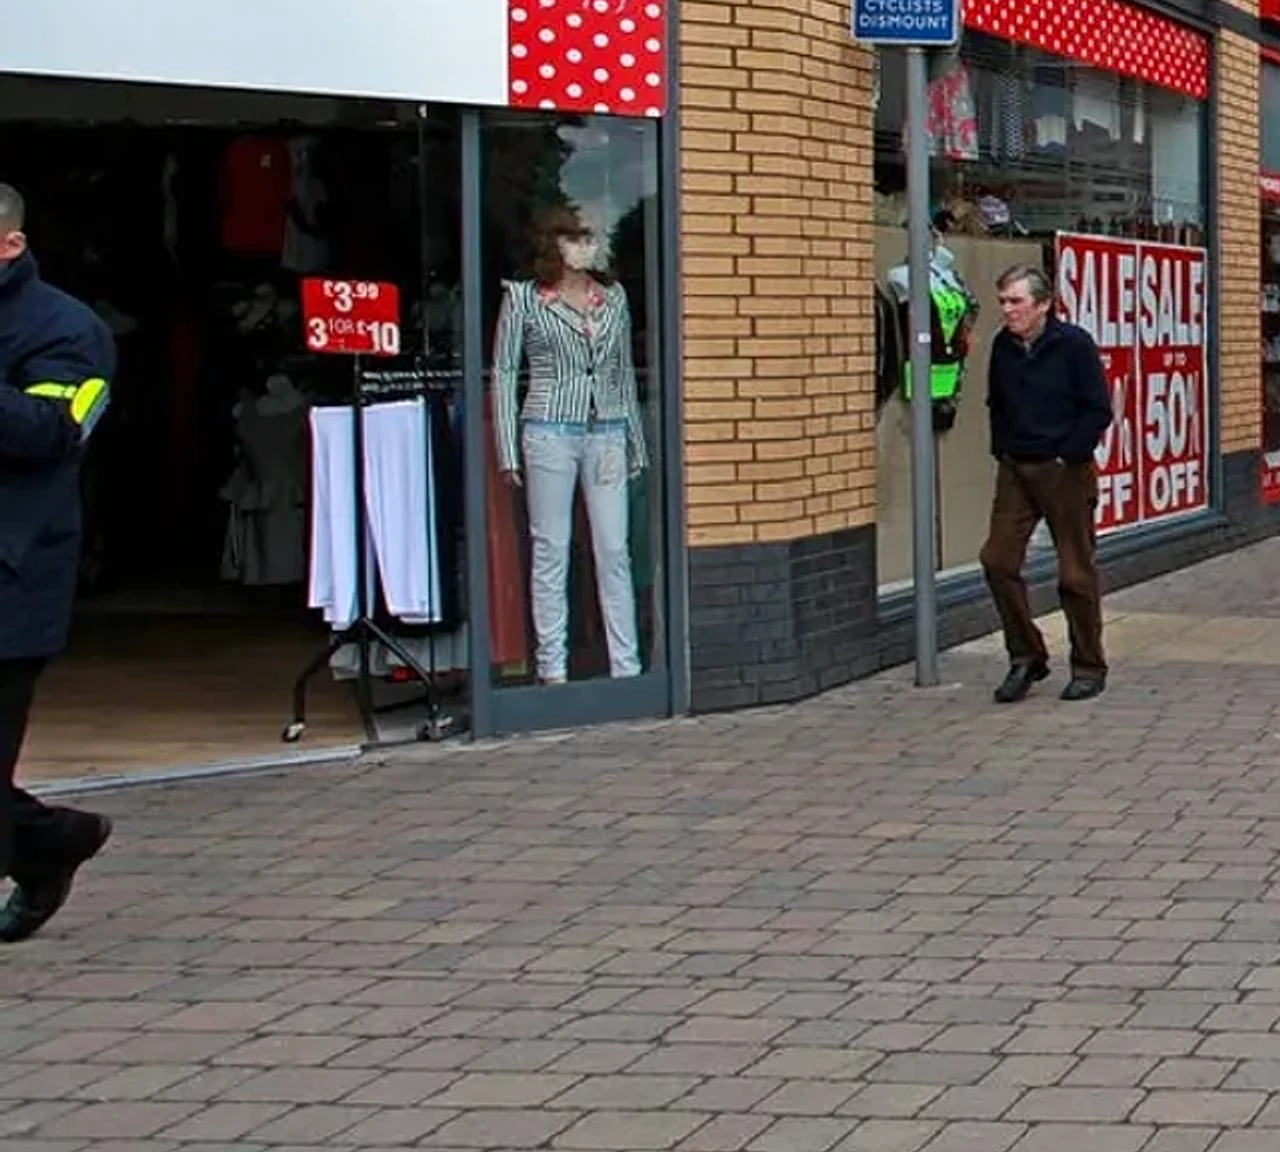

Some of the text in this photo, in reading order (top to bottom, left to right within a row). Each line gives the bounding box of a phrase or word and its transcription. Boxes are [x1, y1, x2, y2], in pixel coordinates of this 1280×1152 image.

[859, 13, 949, 30] DISMOUNT
[1055, 246, 1136, 347] SALE
[1140, 254, 1204, 348] SALE
[308, 316, 329, 348] 3
[356, 319, 400, 355] £10
[1145, 369, 1201, 462] 50%
[1094, 472, 1135, 524] FF
[1150, 459, 1201, 512] OFF
